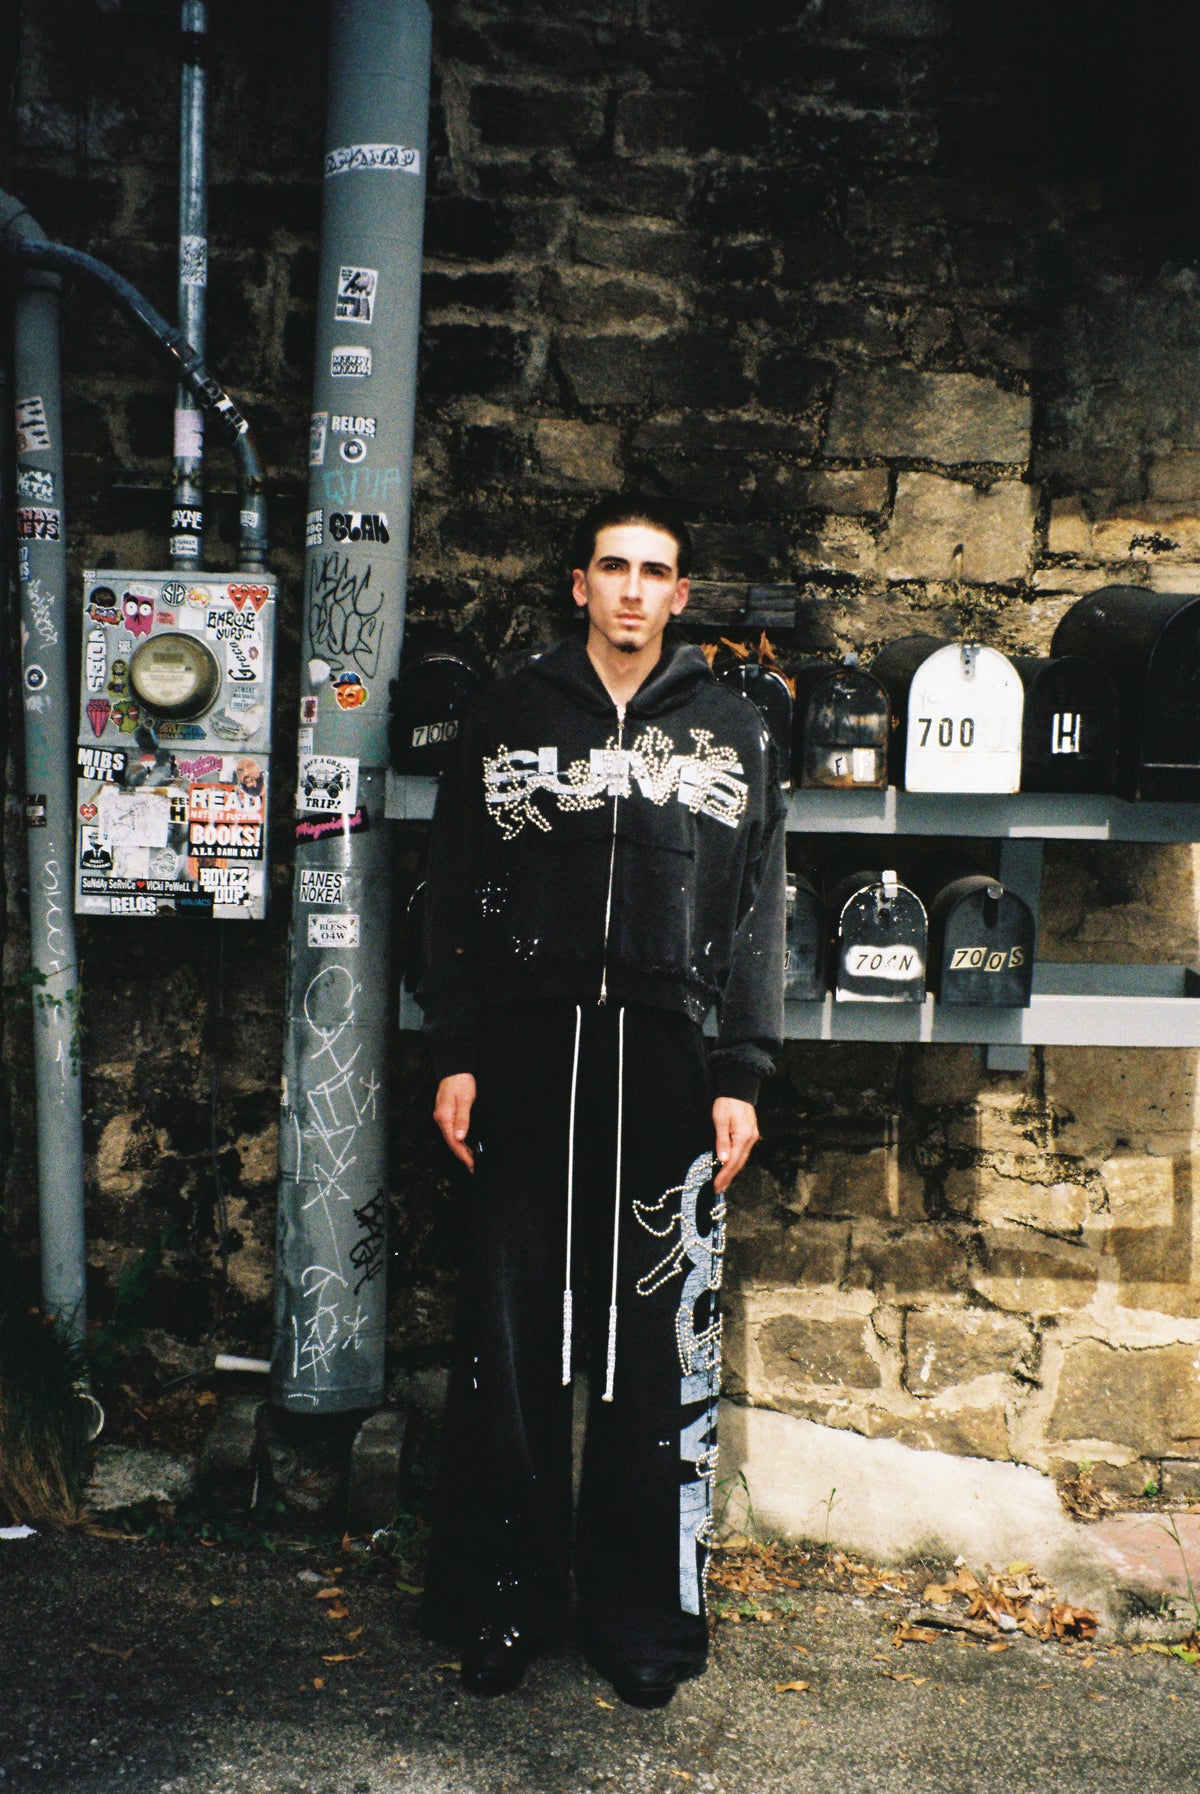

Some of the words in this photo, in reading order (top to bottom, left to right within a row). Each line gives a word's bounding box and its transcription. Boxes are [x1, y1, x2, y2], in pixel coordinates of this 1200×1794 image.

[332, 415, 376, 434] RELOS
[414, 721, 458, 746] 700
[918, 717, 975, 747] 700
[78, 747, 125, 771] MIBS
[83, 765, 114, 781] UTL
[192, 788, 263, 812] READ
[305, 798, 341, 809] TRIP!
[190, 809, 224, 820] MOTER
[190, 823, 261, 847] BOOKS!
[191, 847, 215, 856] ALL
[217, 847, 238, 857] DAMN
[240, 848, 259, 857] DAY
[302, 872, 342, 888] LANES
[301, 887, 341, 903] NOKEA
[110, 896, 157, 913] RELOS
[856, 953, 913, 970] 70N
